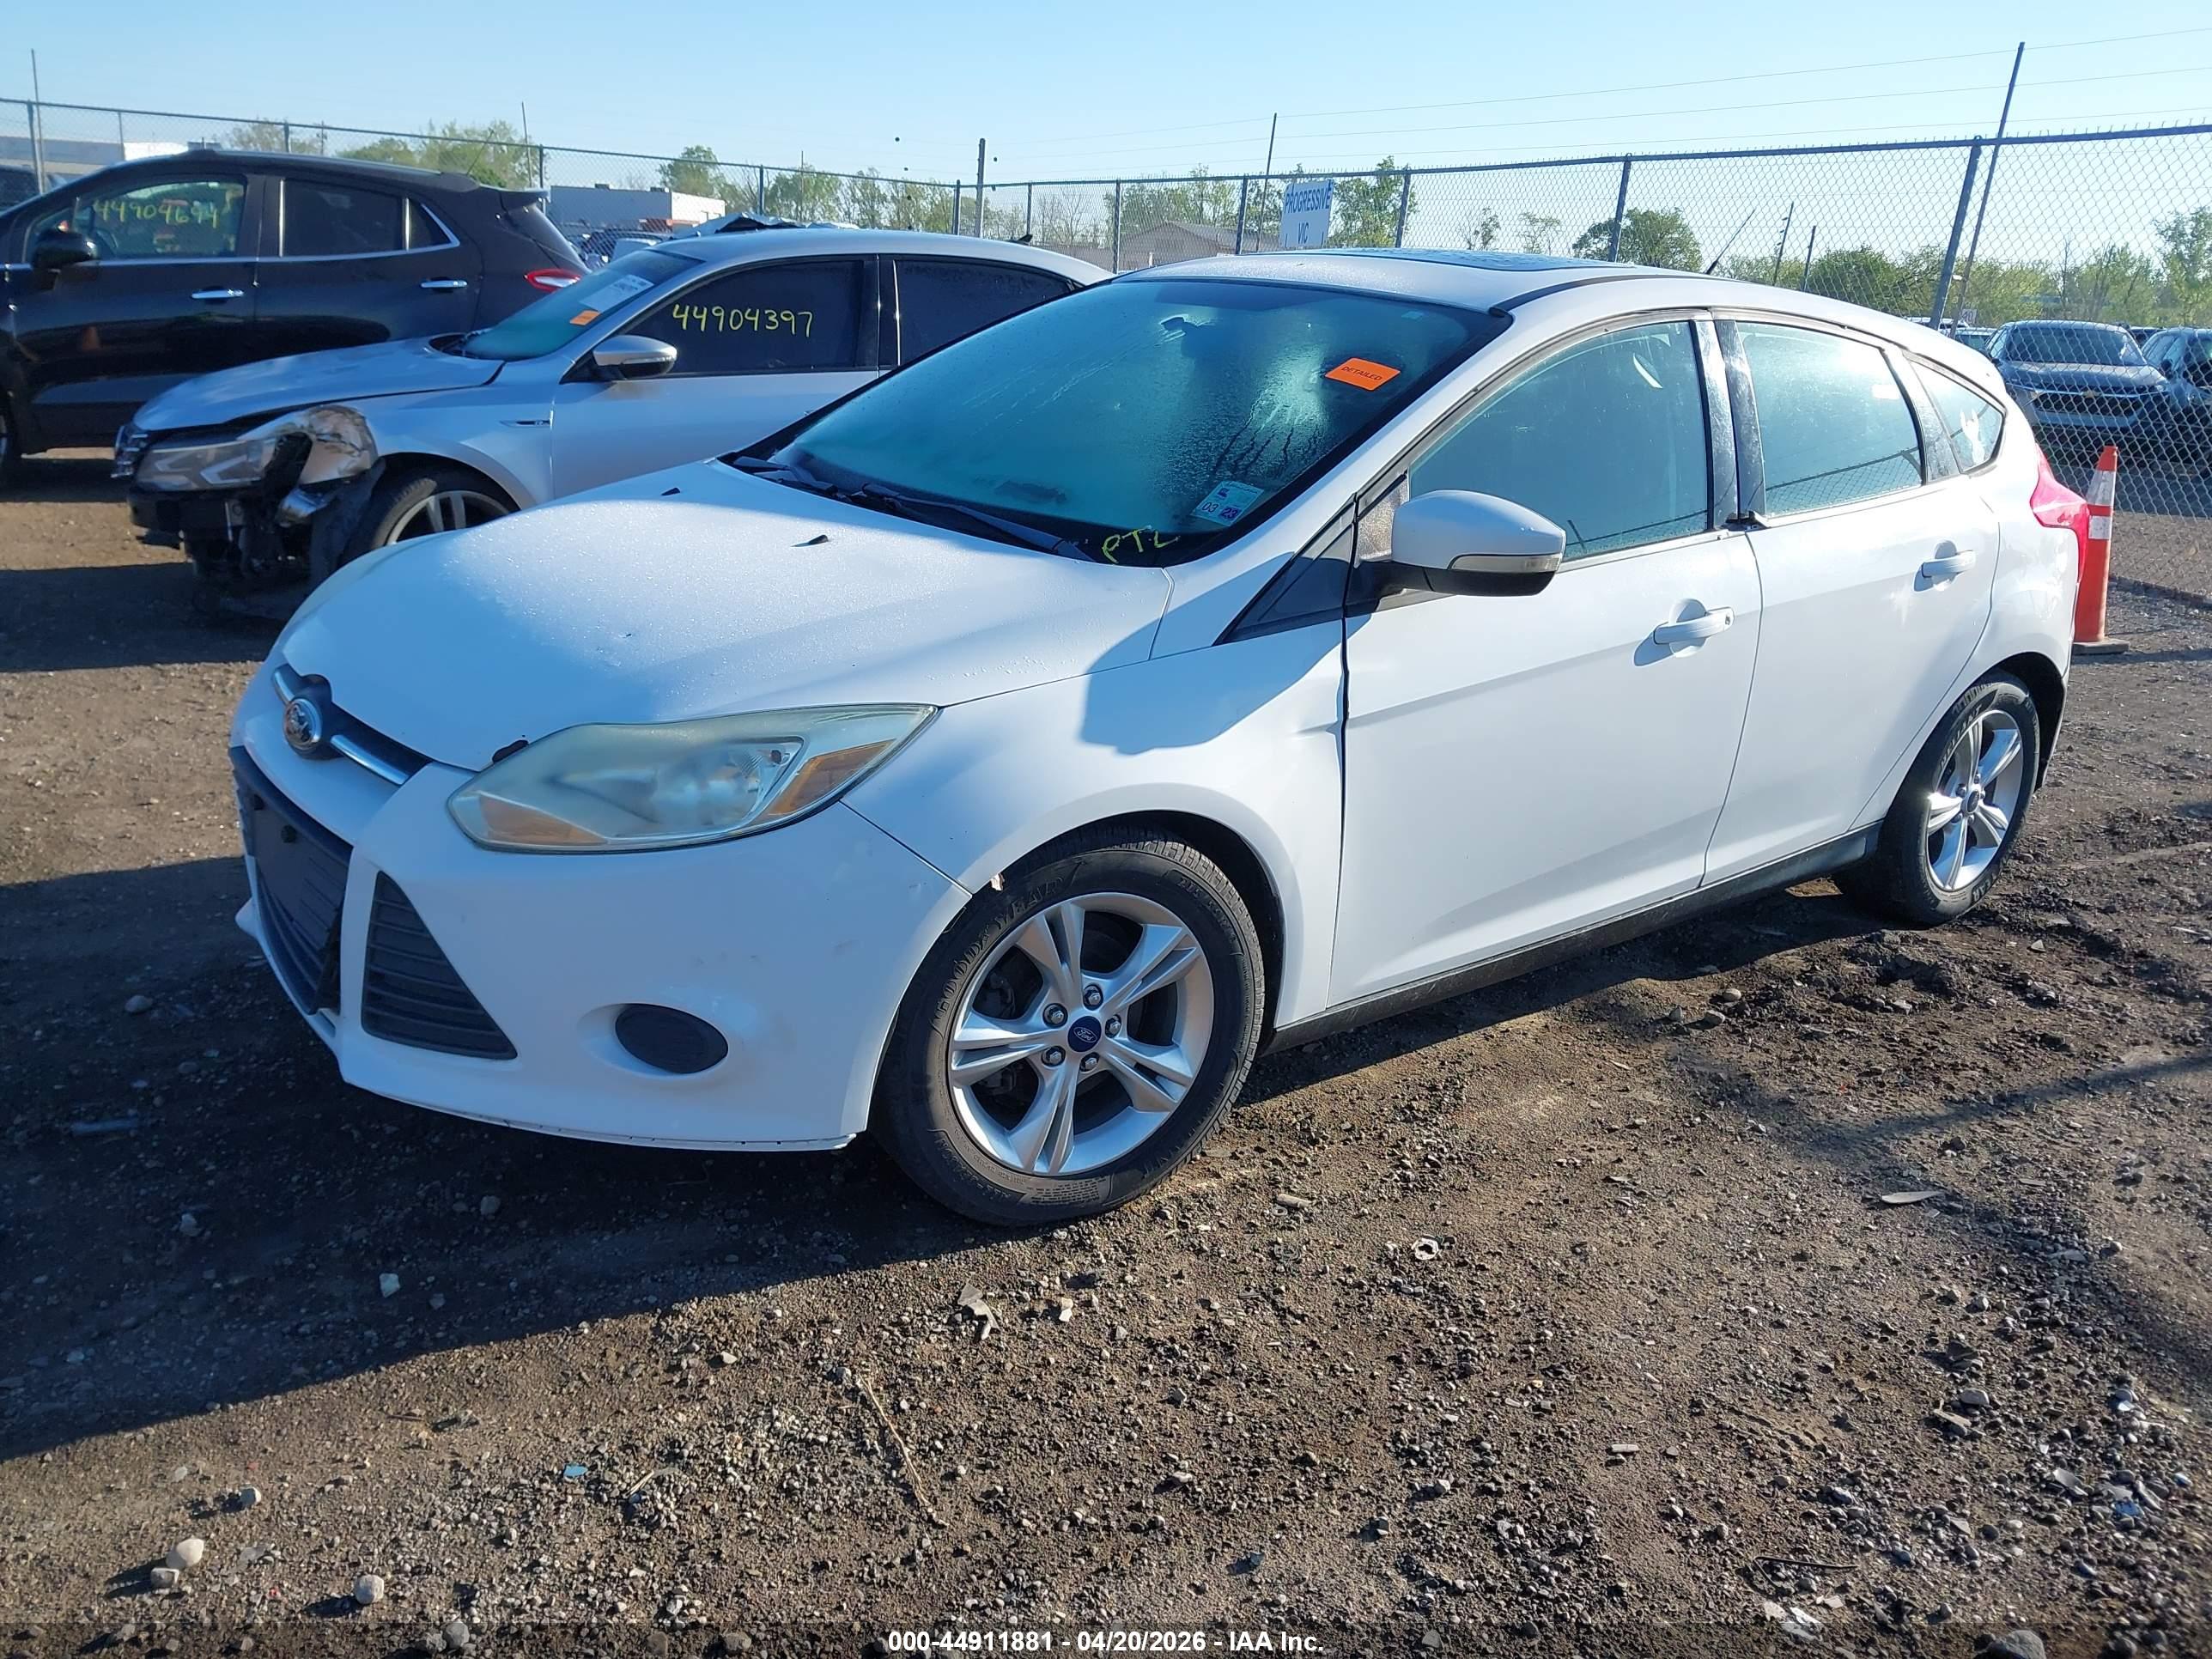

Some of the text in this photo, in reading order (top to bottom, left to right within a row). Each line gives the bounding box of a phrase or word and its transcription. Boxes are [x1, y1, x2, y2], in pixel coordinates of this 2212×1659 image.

[1285, 188, 1331, 214] PROGRESSIVE
[1298, 222, 1310, 244] VIC
[672, 304, 813, 337] 44904397
[1341, 366, 1383, 381] DETAILED
[1202, 502, 1218, 513] 03
